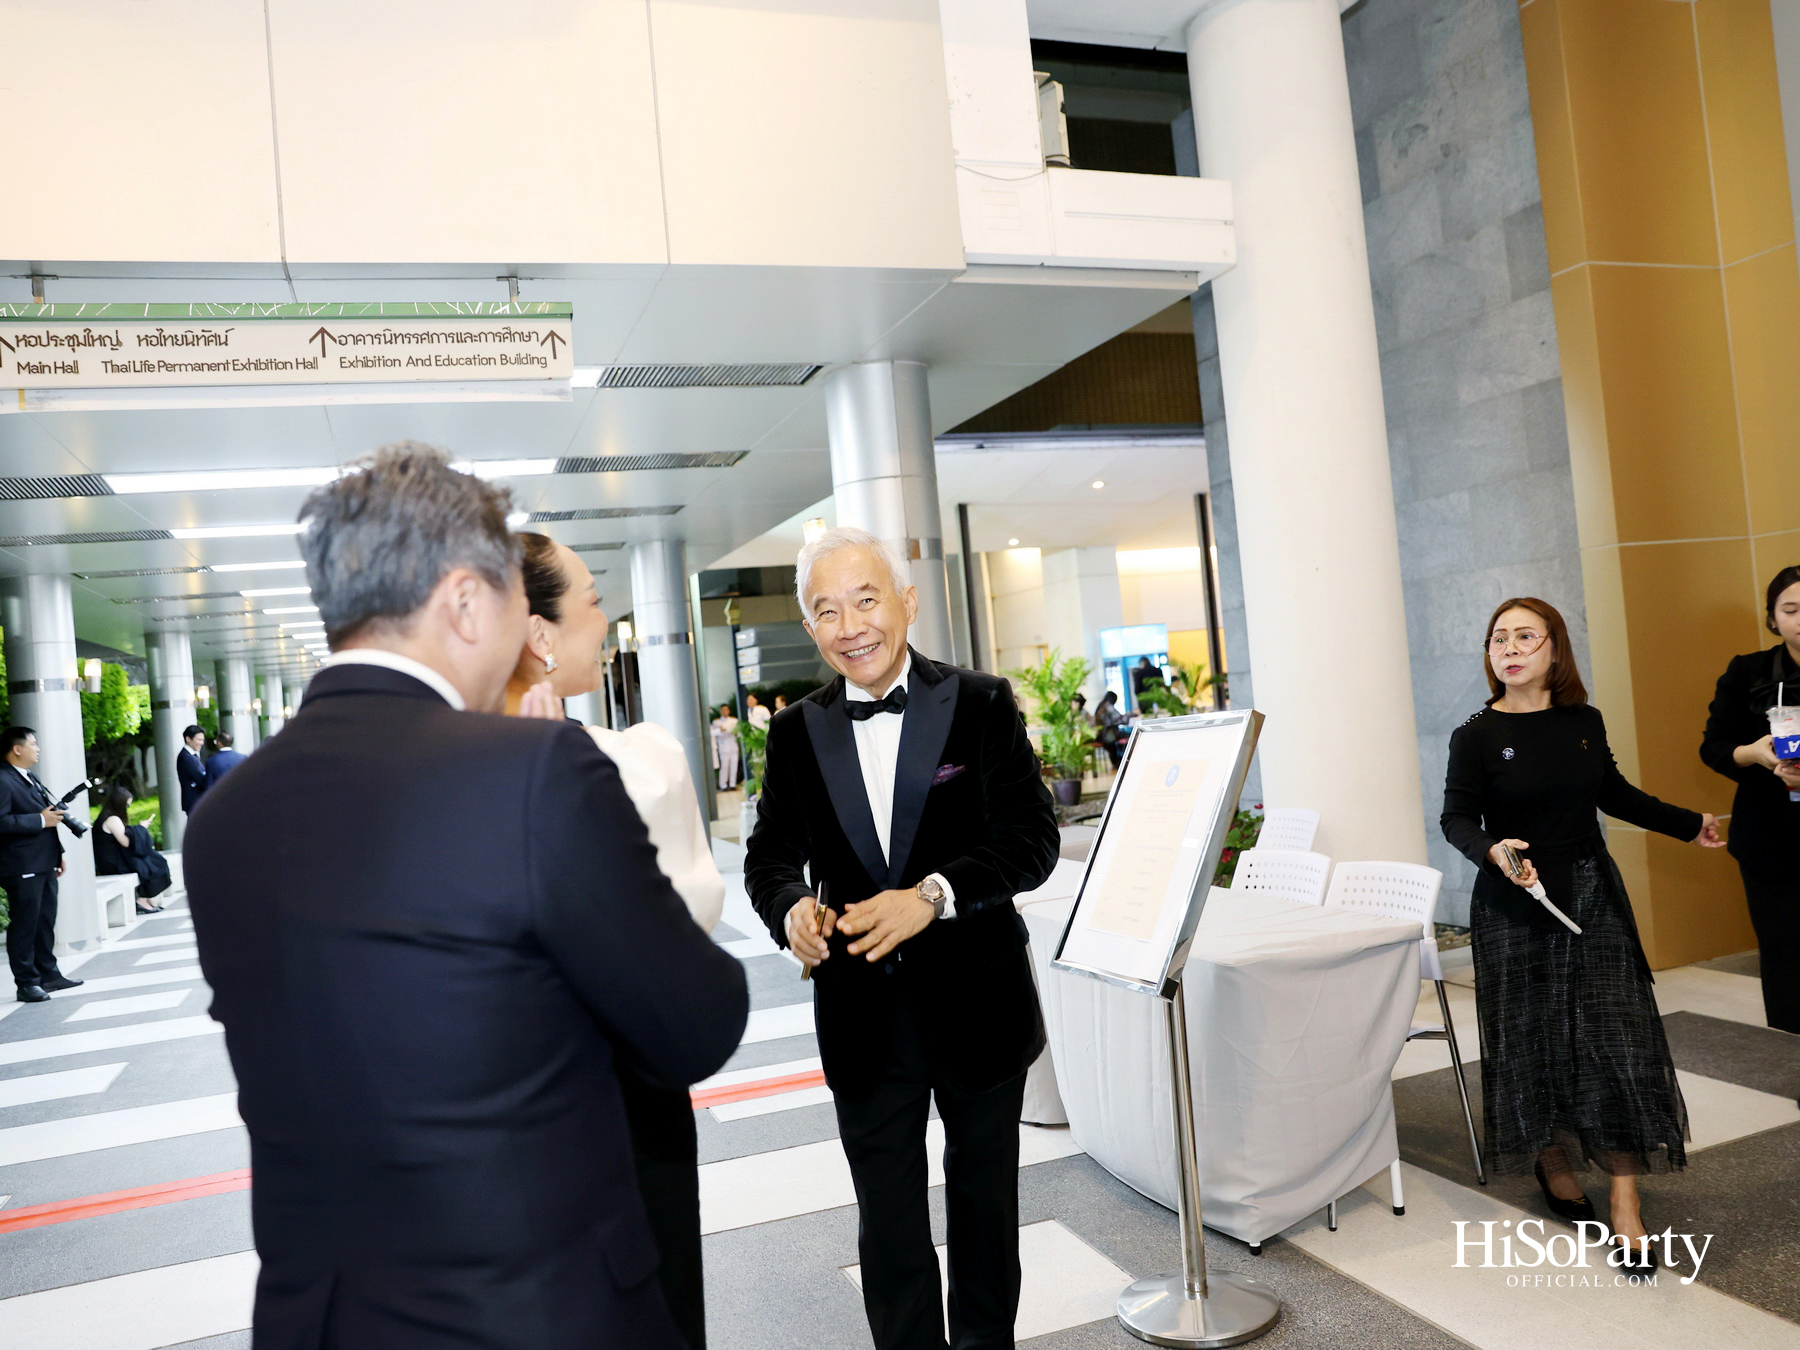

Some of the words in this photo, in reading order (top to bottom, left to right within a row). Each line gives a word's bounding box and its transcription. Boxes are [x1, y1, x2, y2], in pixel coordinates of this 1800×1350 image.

[14, 328, 122, 352] หอประชุมใหญ่
[137, 327, 235, 347] หอไทยนิทัศน์
[337, 326, 539, 346] อาคารนิทรรศการและการศึกษา
[17, 361, 51, 375] Main
[54, 360, 79, 374] Hall
[102, 360, 131, 373] Thai
[133, 360, 155, 373] Life
[157, 360, 230, 373] Permanent
[232, 358, 292, 371] Exhibition
[295, 357, 318, 370] Hall
[339, 356, 401, 369] Exhibition
[406, 355, 432, 367] And
[435, 354, 497, 367] Education
[500, 353, 548, 368] Building
